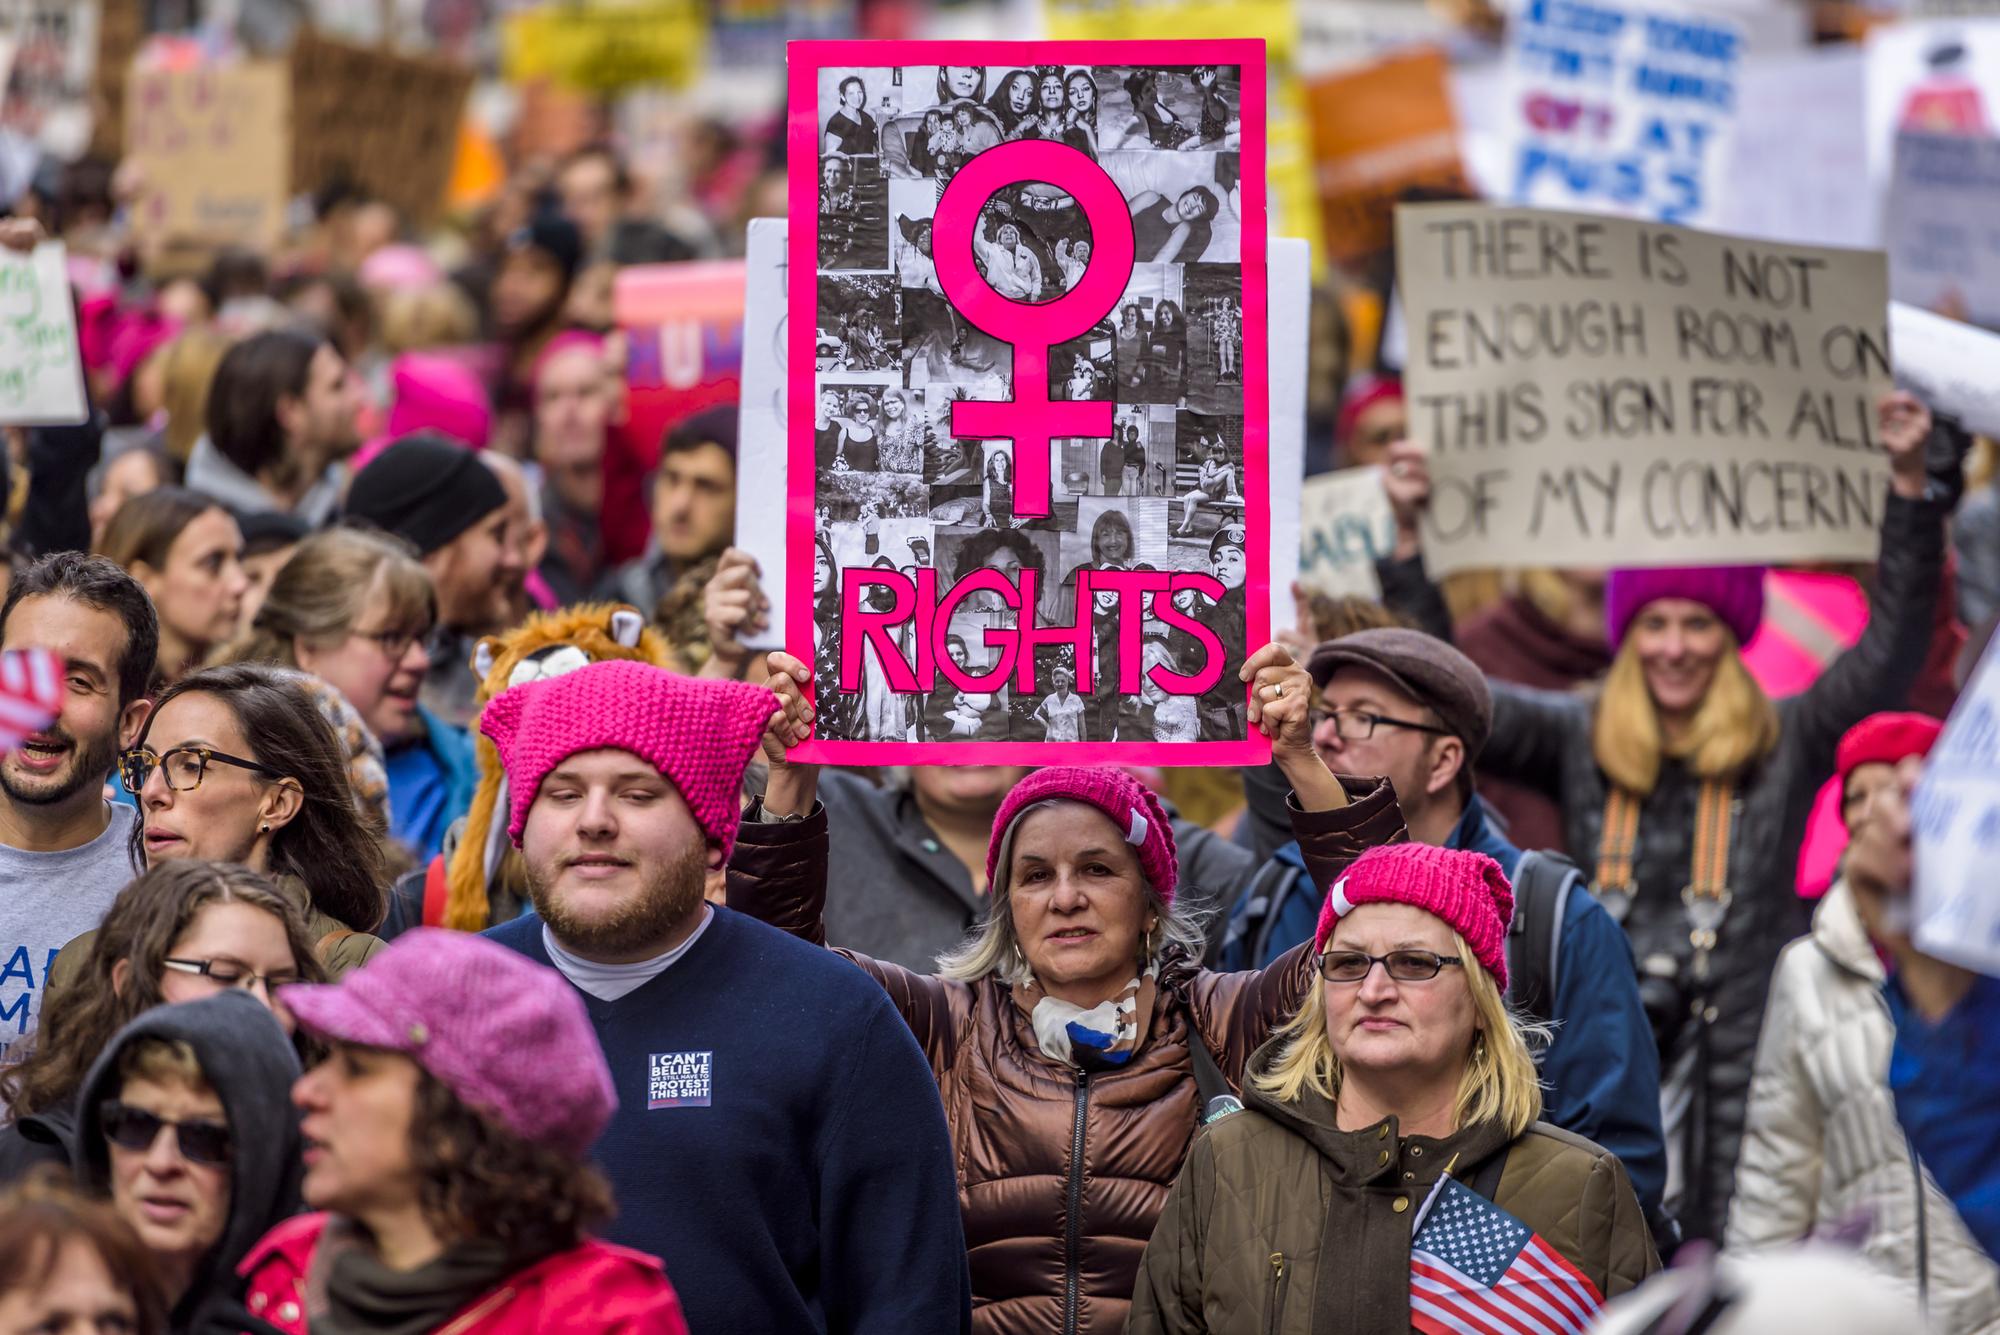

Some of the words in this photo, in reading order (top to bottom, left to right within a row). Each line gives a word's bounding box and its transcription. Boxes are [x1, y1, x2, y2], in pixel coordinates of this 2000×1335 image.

[1425, 218, 1613, 282] THERE
[1638, 229, 1688, 287] IS
[1723, 246, 1829, 312] NOT
[1426, 301, 1649, 369] ENOUGH
[1674, 304, 1801, 372] ROOM
[1820, 325, 1892, 380] ON
[1417, 381, 1548, 452] THIS
[1565, 377, 1675, 441] SIGN
[1690, 378, 1770, 440] FOR
[1787, 387, 1888, 453] ALL
[1428, 467, 1511, 545] OF
[1527, 461, 1620, 540] MY
[839, 566, 1228, 695] RIGHTS
[650, 1089, 678, 1100] THIS
[680, 1088, 709, 1097] SHIT
[651, 1064, 710, 1077] BELIEVE
[651, 1079, 709, 1090] PROTEST
[652, 1056, 656, 1066] I
[660, 1053, 710, 1066] CAN'T
